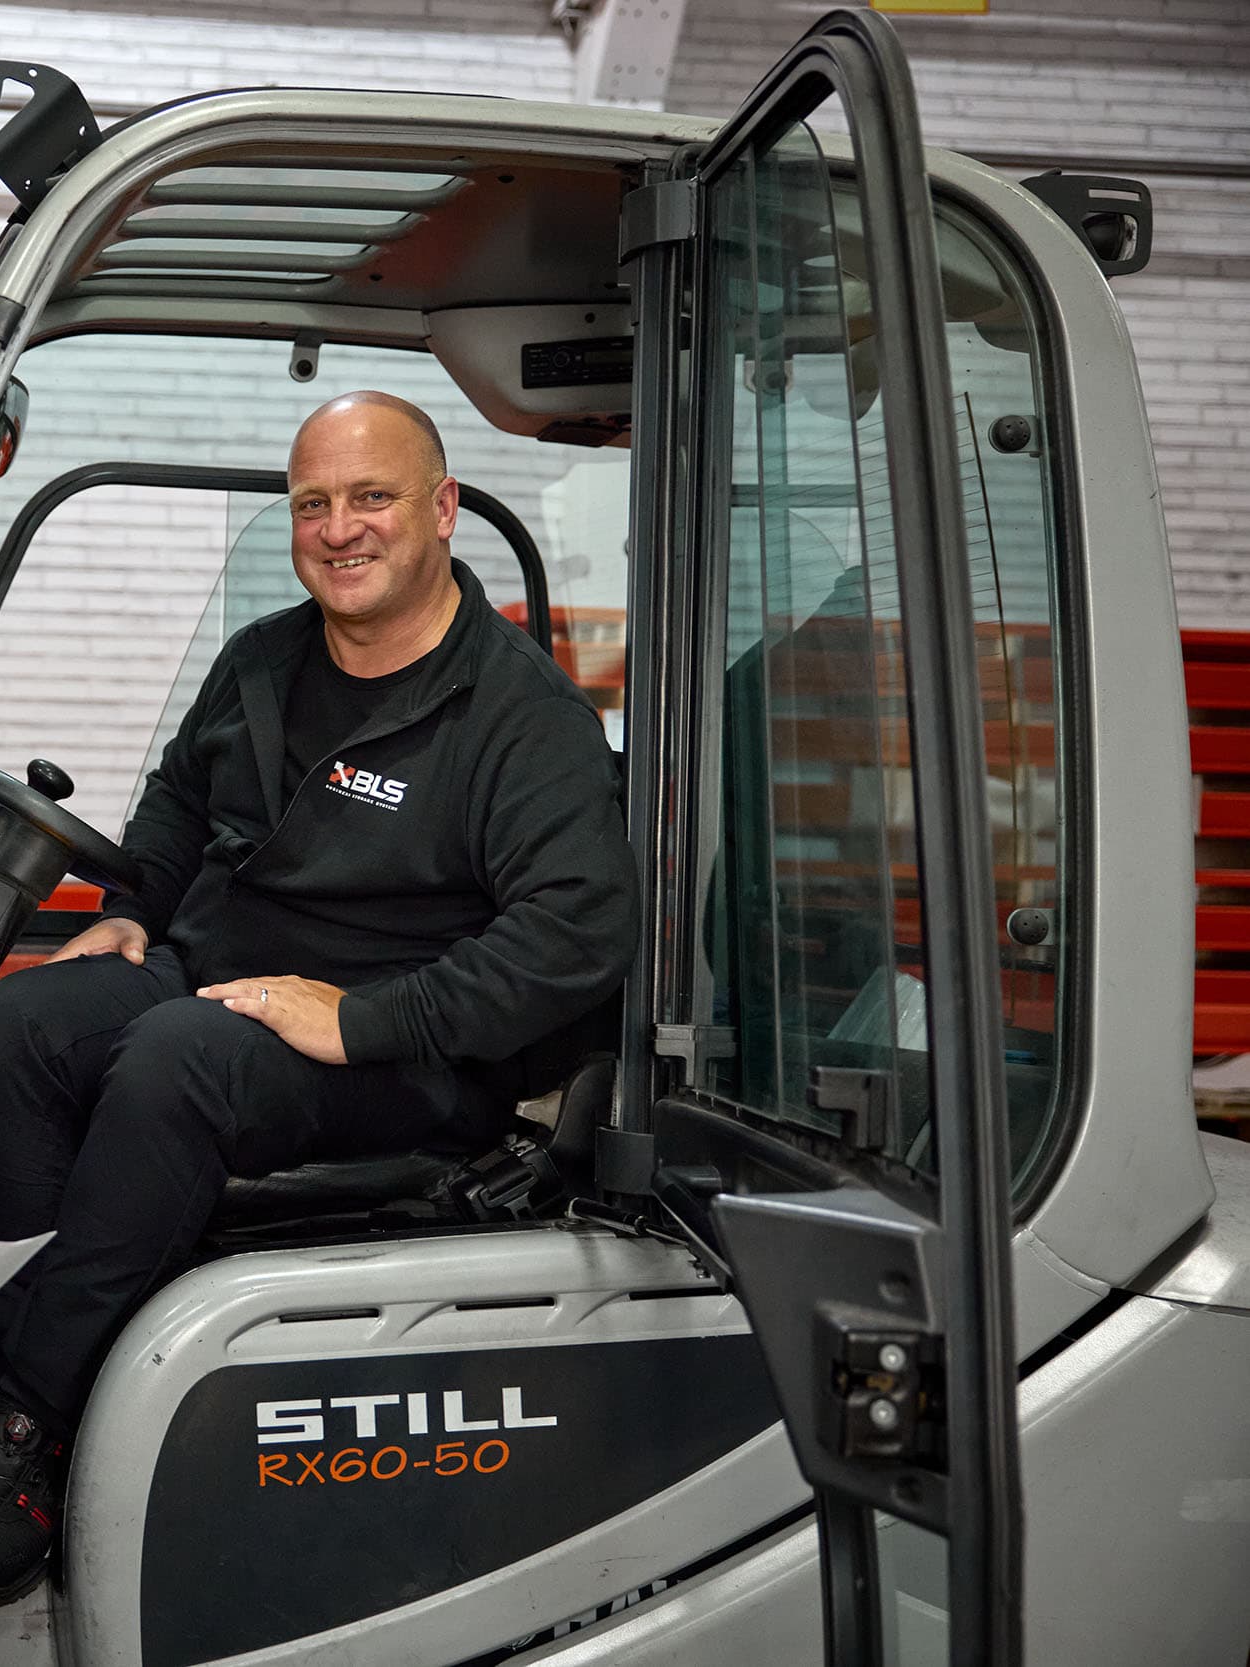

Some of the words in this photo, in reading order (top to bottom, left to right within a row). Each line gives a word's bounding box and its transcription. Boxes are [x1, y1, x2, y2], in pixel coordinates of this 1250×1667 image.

[350, 770, 409, 804] BLS
[256, 1386, 557, 1444] STILL
[258, 1439, 510, 1487] RX60-50
